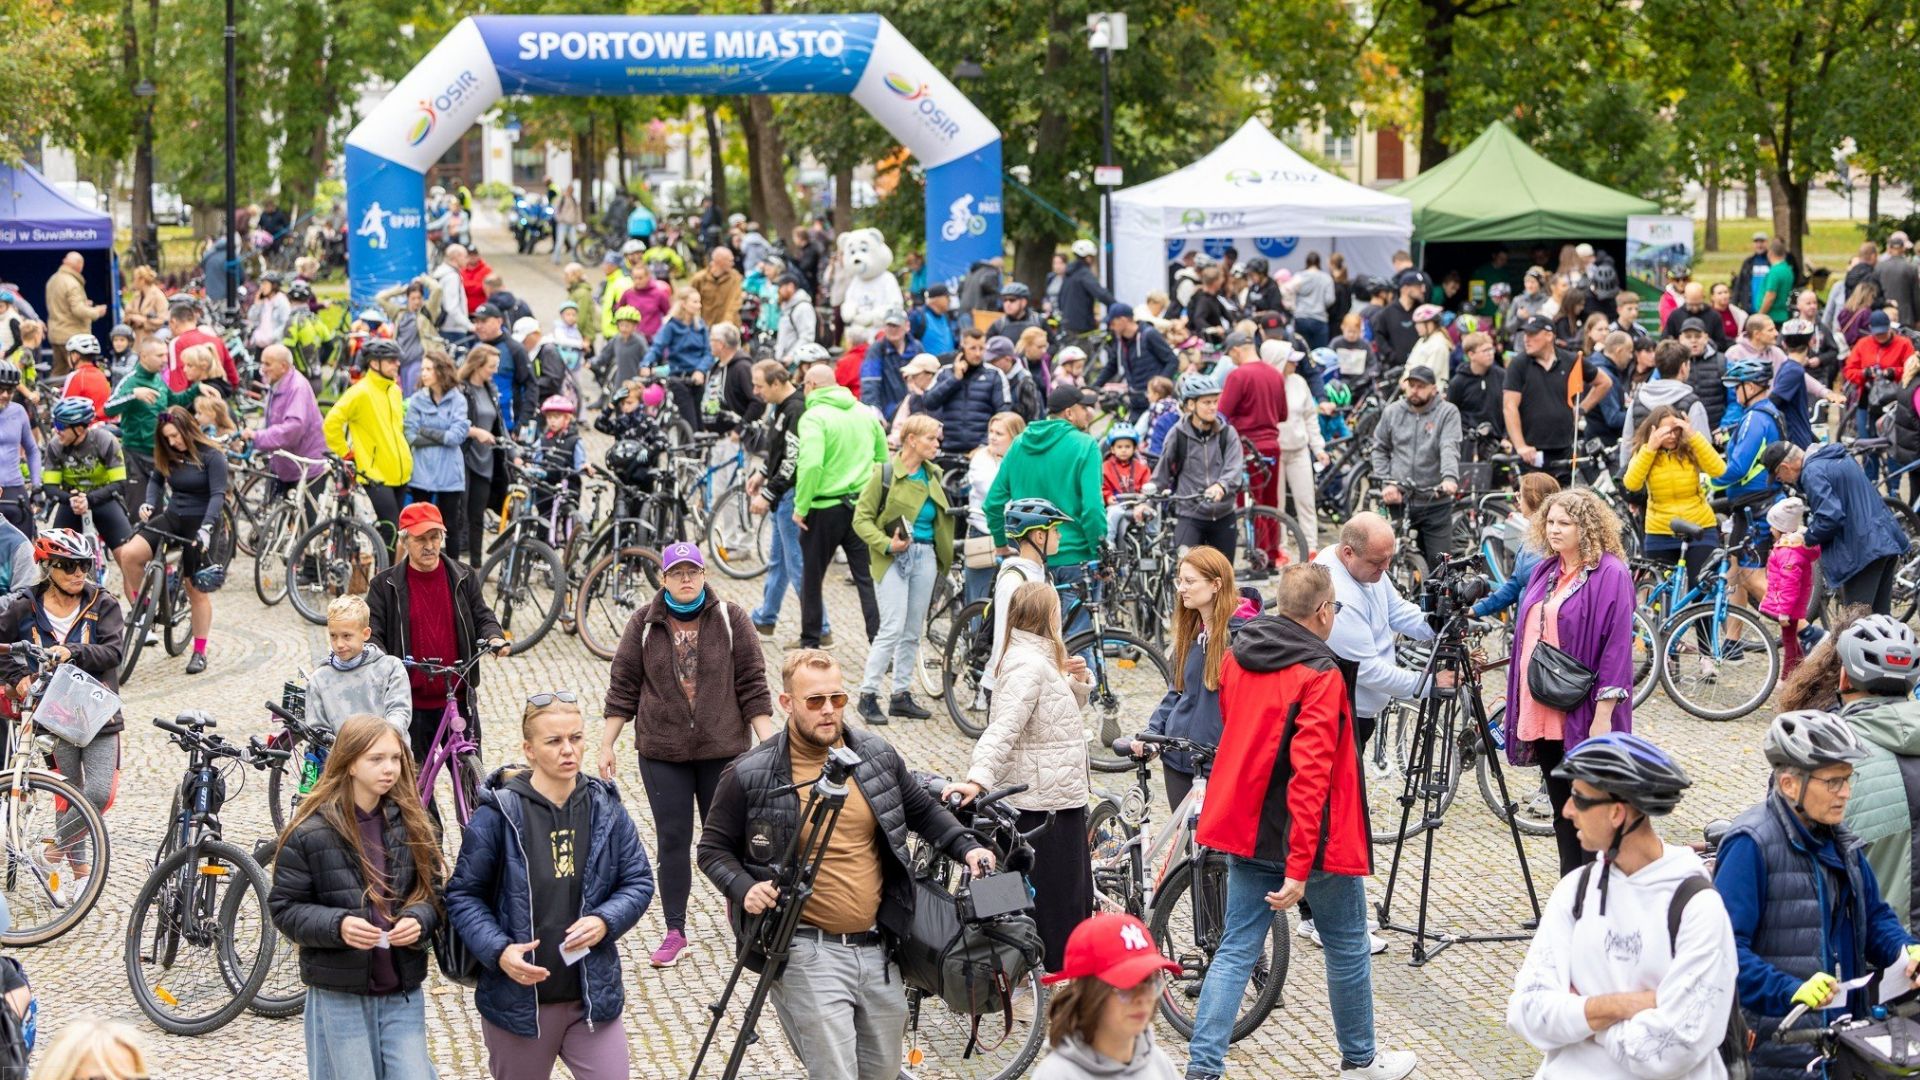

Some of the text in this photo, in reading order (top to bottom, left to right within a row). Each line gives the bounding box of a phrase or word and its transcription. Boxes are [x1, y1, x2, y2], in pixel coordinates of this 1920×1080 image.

[518, 29, 845, 60] SPORTOWE MIASTO
[19, 231, 31, 242] w
